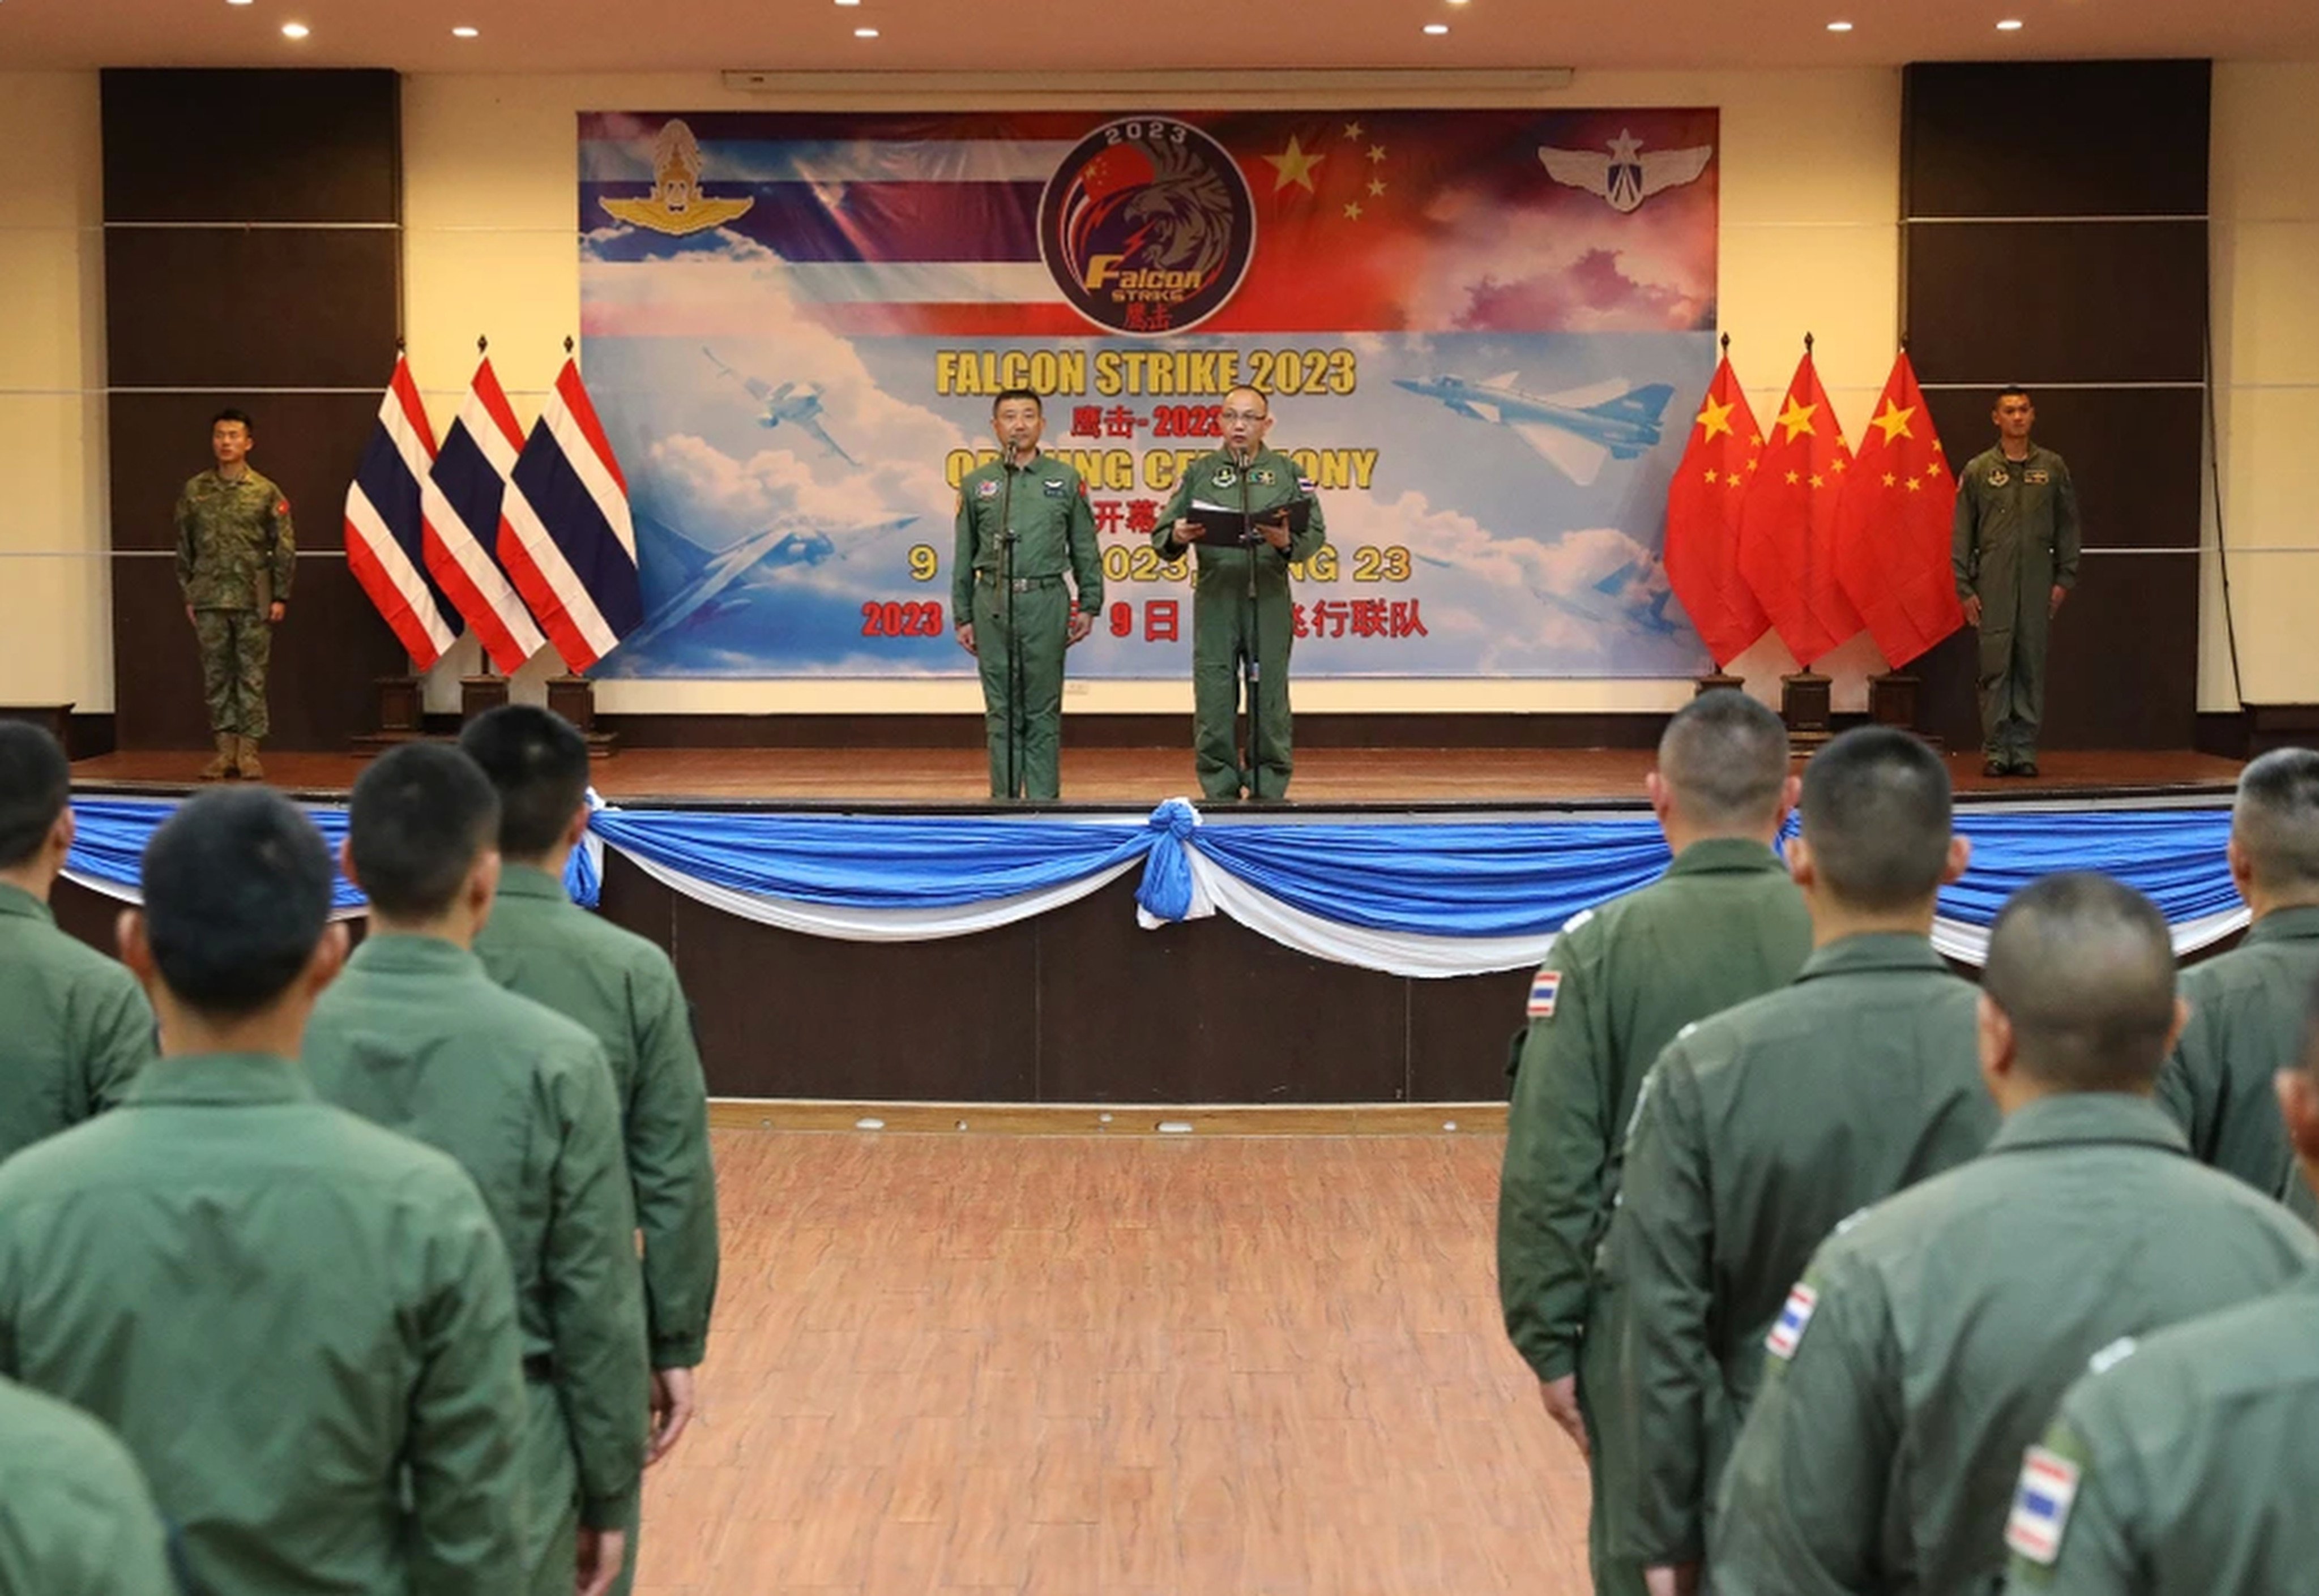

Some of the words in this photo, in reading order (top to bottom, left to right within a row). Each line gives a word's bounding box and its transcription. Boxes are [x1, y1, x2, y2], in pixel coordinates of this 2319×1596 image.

[1105, 122, 1187, 144] 2023
[1086, 254, 1202, 289] Falcon
[1111, 289, 1184, 302] STRIKE
[936, 350, 1086, 396] FALCON
[1094, 350, 1240, 396] STRIKE
[1248, 348, 1357, 395] 2023
[1144, 449, 1380, 491] CEONY
[1093, 499, 1165, 533] 开幕
[908, 544, 938, 582] 9
[1103, 544, 1197, 589] 023,
[1353, 545, 1412, 582] 23
[861, 600, 943, 637] 2023
